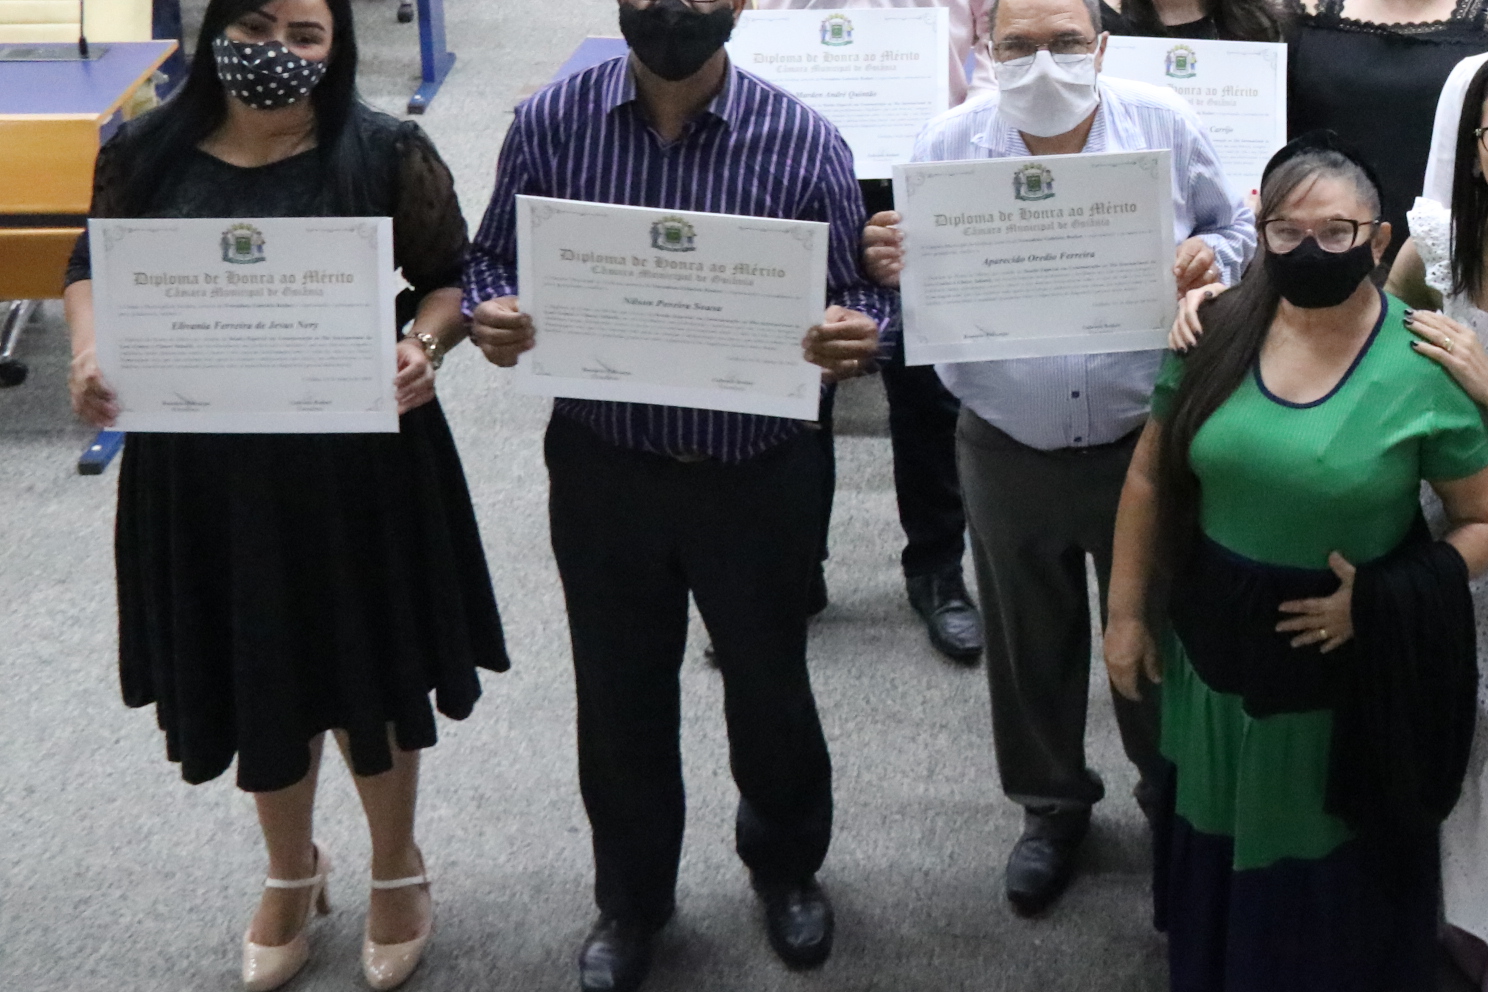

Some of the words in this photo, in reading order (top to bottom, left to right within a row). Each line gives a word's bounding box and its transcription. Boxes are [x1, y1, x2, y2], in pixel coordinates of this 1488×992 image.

[753, 53, 802, 64] Diploma
[807, 53, 818, 62] de
[823, 51, 859, 63] Honra
[863, 53, 876, 62] ao
[881, 51, 919, 62] Mérito
[854, 64, 862, 72] de
[1206, 87, 1217, 96] ao
[1222, 84, 1258, 97] Mérito
[934, 213, 994, 227] Diploma
[999, 210, 1013, 222] de
[1019, 207, 1064, 221] Honra
[1068, 207, 1083, 217] ao
[1089, 202, 1137, 217] Mérito
[963, 225, 1001, 236] Câmara
[1006, 222, 1055, 234] Municipal
[1058, 220, 1067, 229] de
[560, 248, 626, 267] Diploma
[632, 256, 647, 268] de
[654, 256, 704, 272] Honra
[710, 263, 726, 273] ao
[733, 263, 786, 278] Mérito
[134, 271, 198, 288] Diploma
[204, 272, 219, 285] de
[226, 270, 275, 285] Honra
[280, 273, 295, 284] ao
[302, 270, 353, 285] Mérito
[165, 286, 206, 298] Câmara
